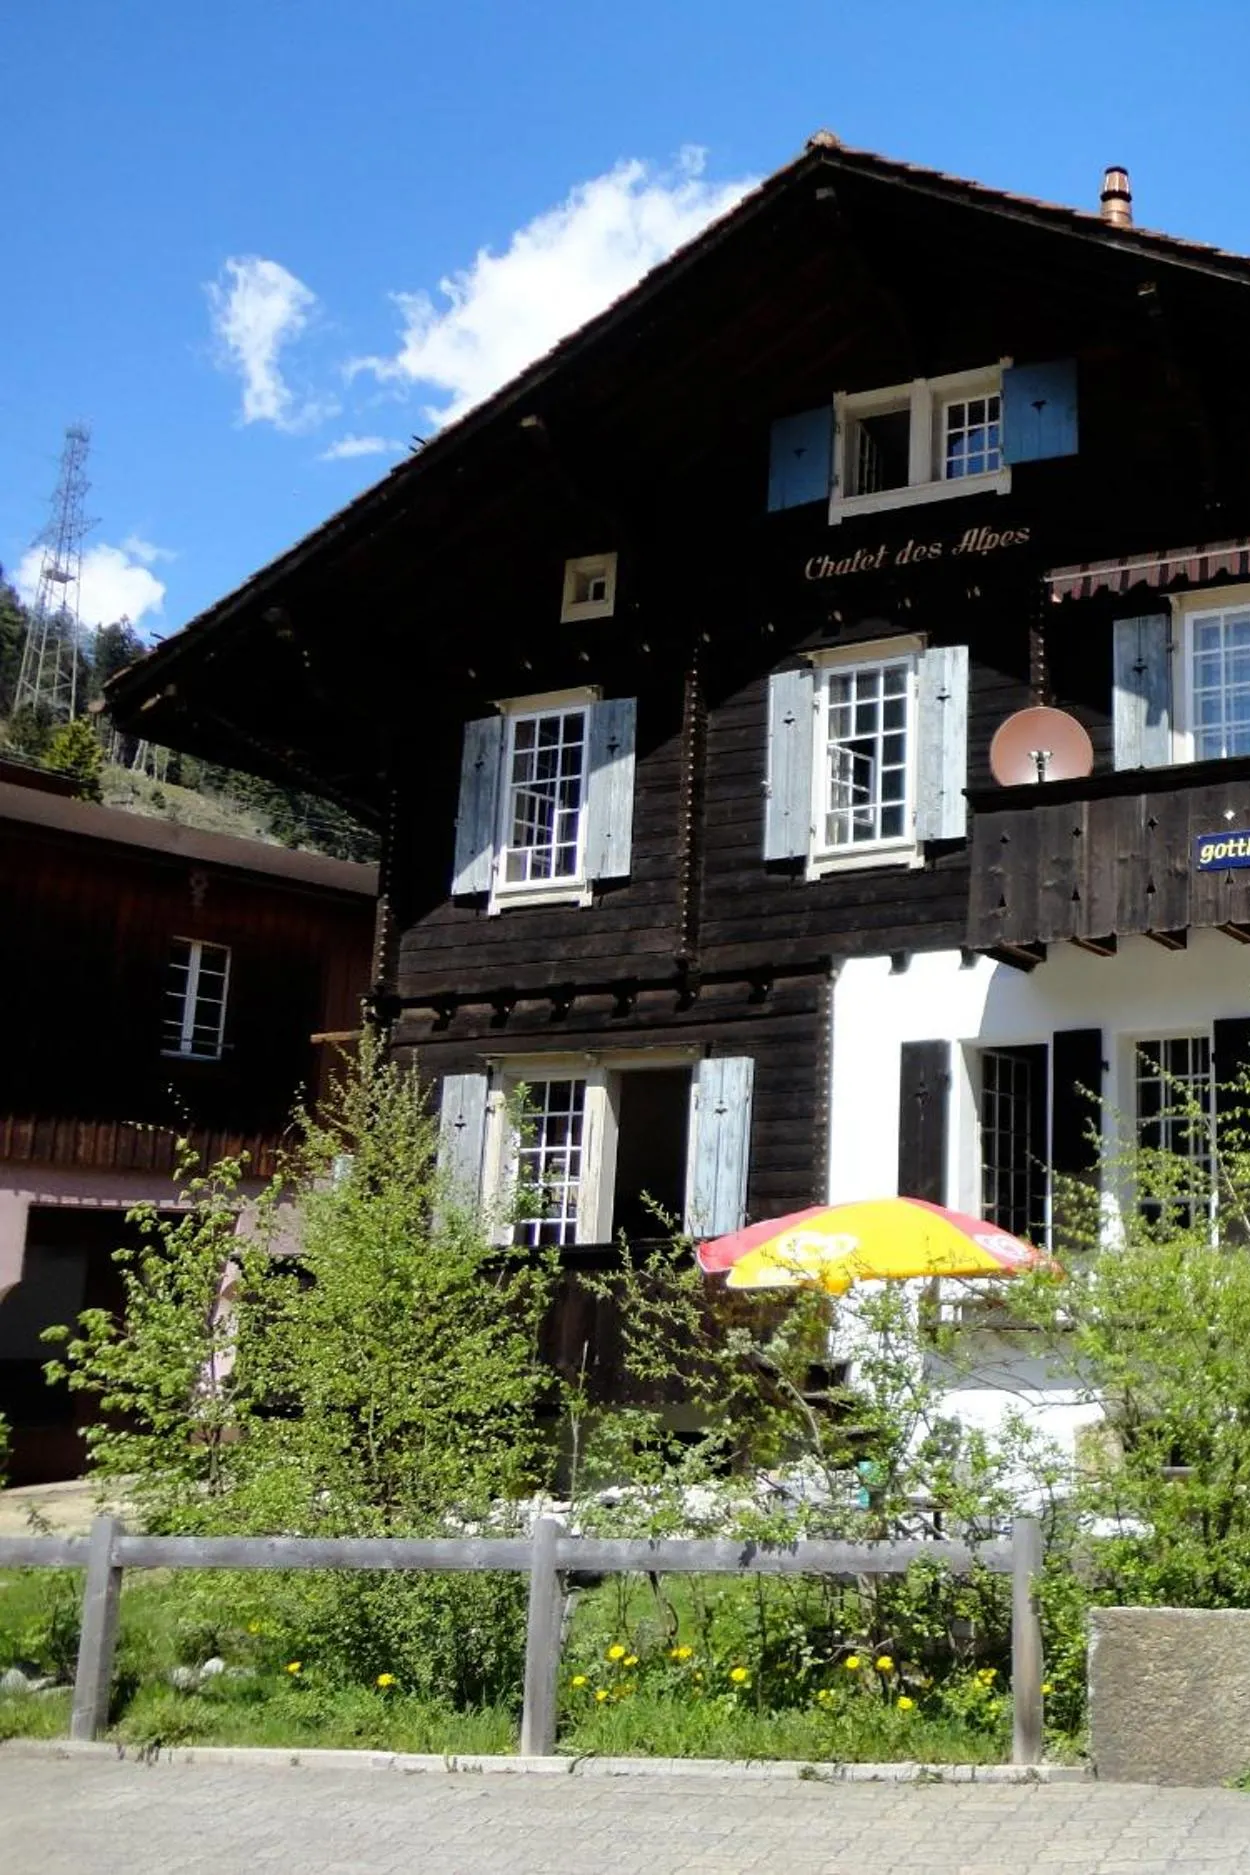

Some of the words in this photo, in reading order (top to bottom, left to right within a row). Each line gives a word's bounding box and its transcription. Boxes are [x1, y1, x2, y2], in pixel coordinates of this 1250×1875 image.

[804, 543, 889, 581] Chalet
[895, 538, 943, 566] des
[951, 525, 1031, 556] Alpes
